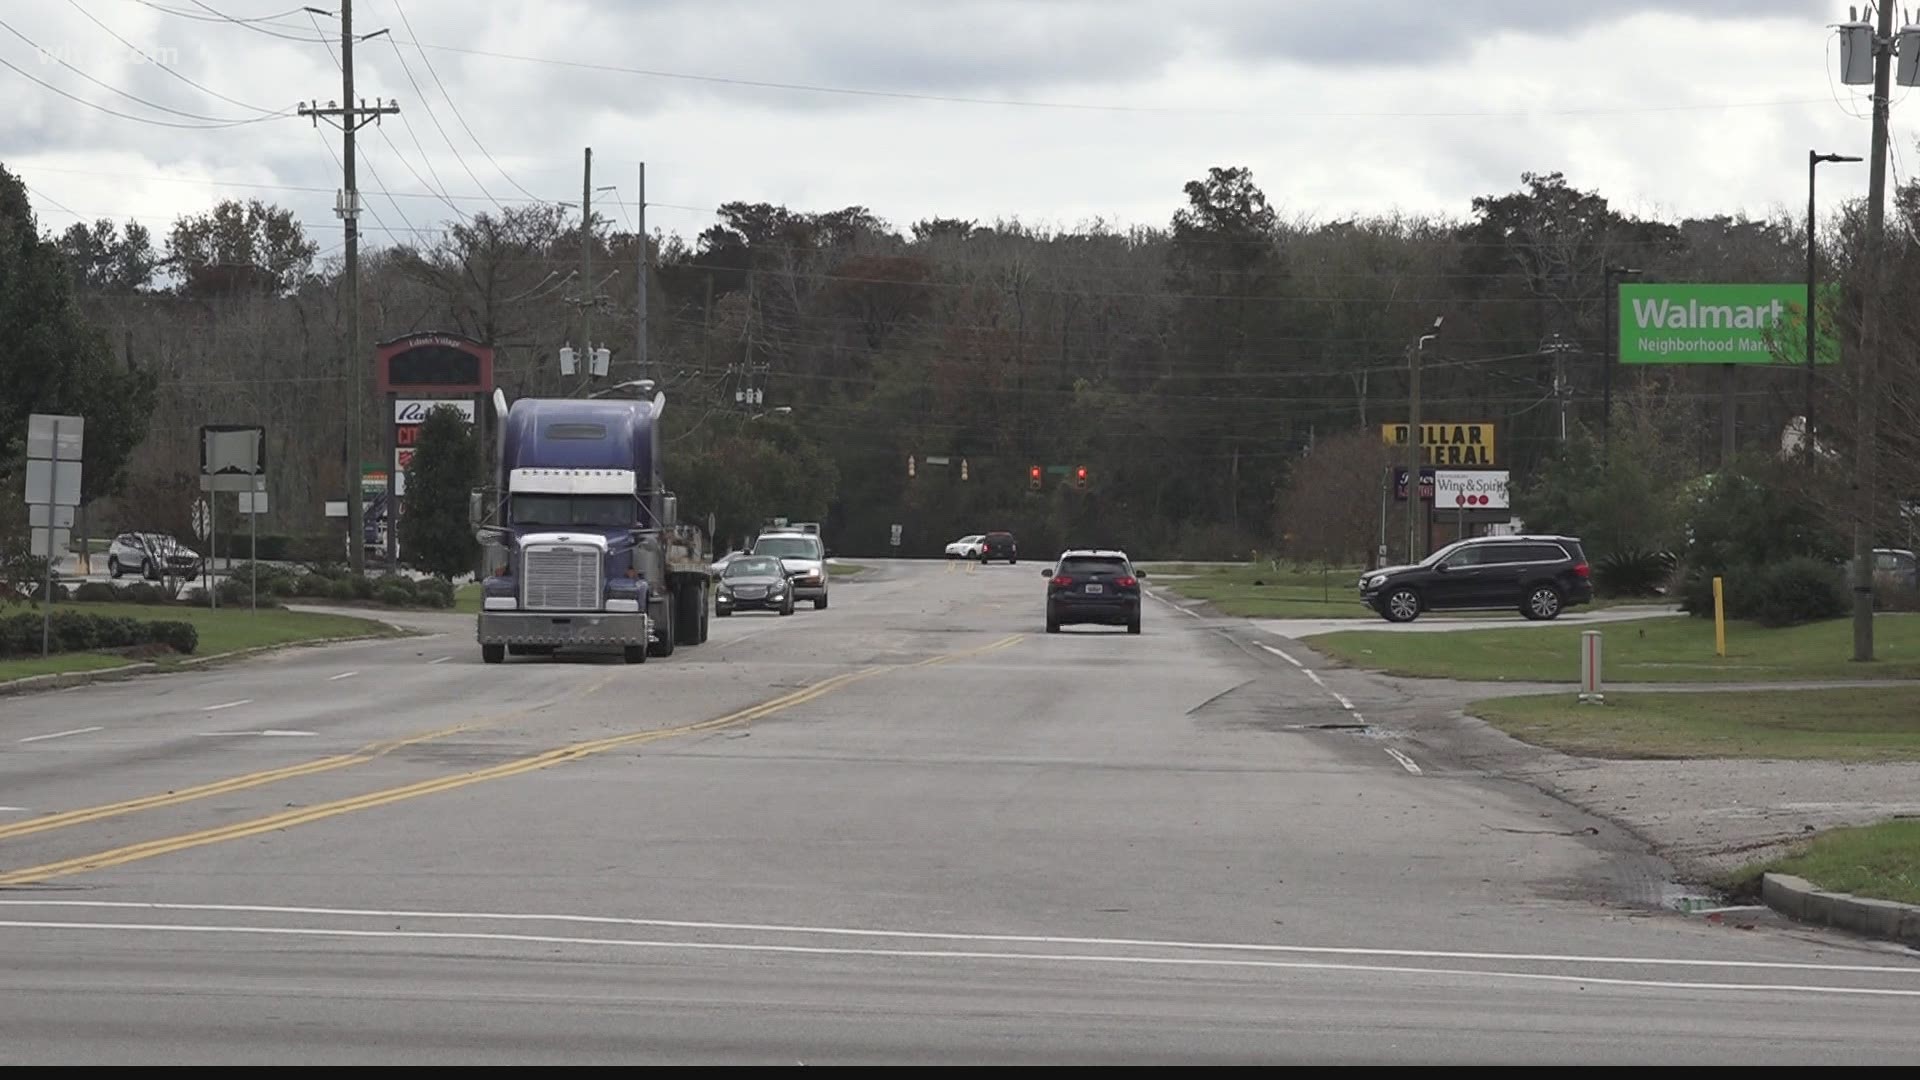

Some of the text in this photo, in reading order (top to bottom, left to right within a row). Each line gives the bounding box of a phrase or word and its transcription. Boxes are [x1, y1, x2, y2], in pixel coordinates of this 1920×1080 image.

[1631, 298, 1784, 329] Walmart
[434, 335, 461, 348] Village
[1638, 337, 1783, 355] Neighborhood Mark
[1395, 426, 1482, 444] DLLAR
